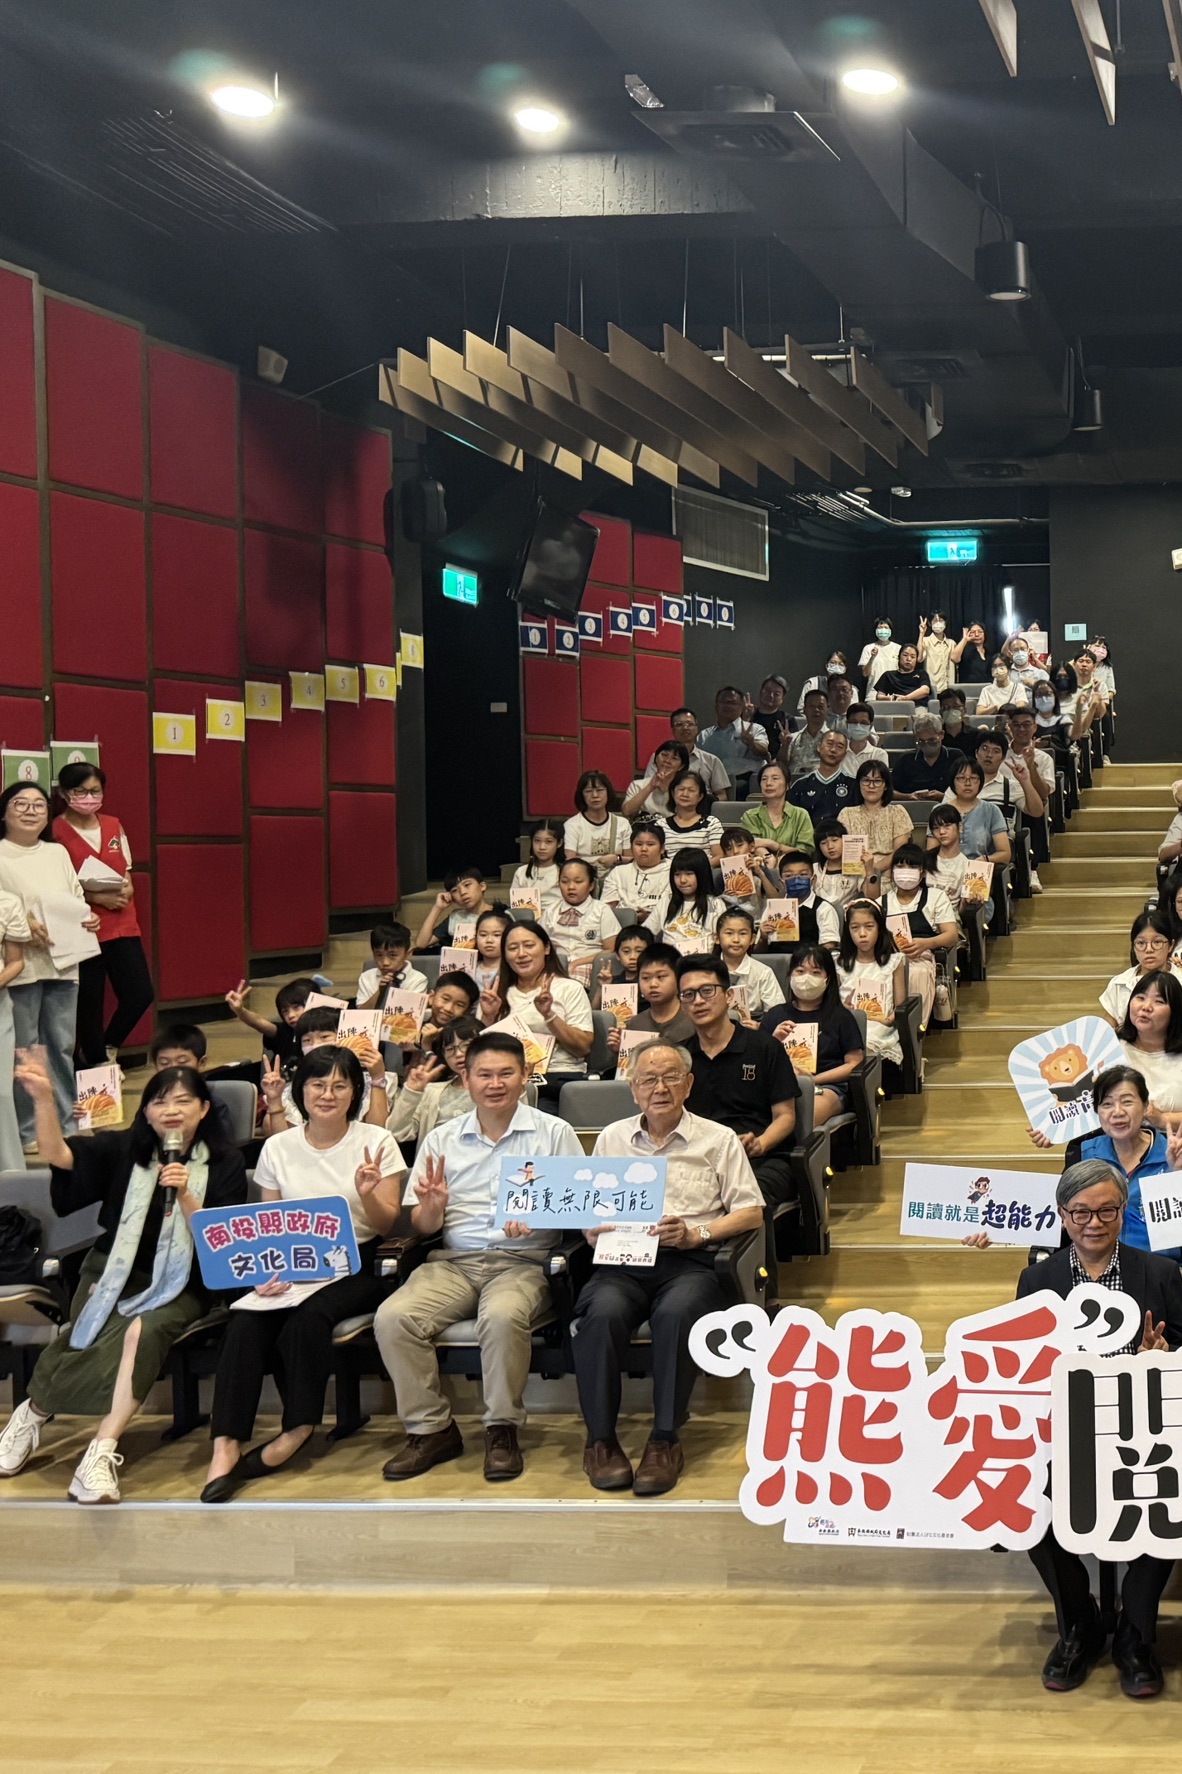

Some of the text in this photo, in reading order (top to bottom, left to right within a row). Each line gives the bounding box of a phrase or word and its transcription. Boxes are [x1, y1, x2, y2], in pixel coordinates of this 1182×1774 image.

[340, 678, 347, 690] 5
[378, 675, 385, 687] 6
[305, 685, 313, 697] 4
[260, 694, 267, 707] 3
[224, 713, 231, 726] 2
[171, 727, 178, 740] 1
[25, 766, 33, 780] 8
[505, 1186, 654, 1214] 閱讀無限可能
[907, 1199, 1056, 1232] 閱讀就是超能力
[203, 1209, 341, 1252] 南投縣政府
[230, 1245, 318, 1279] 文化局
